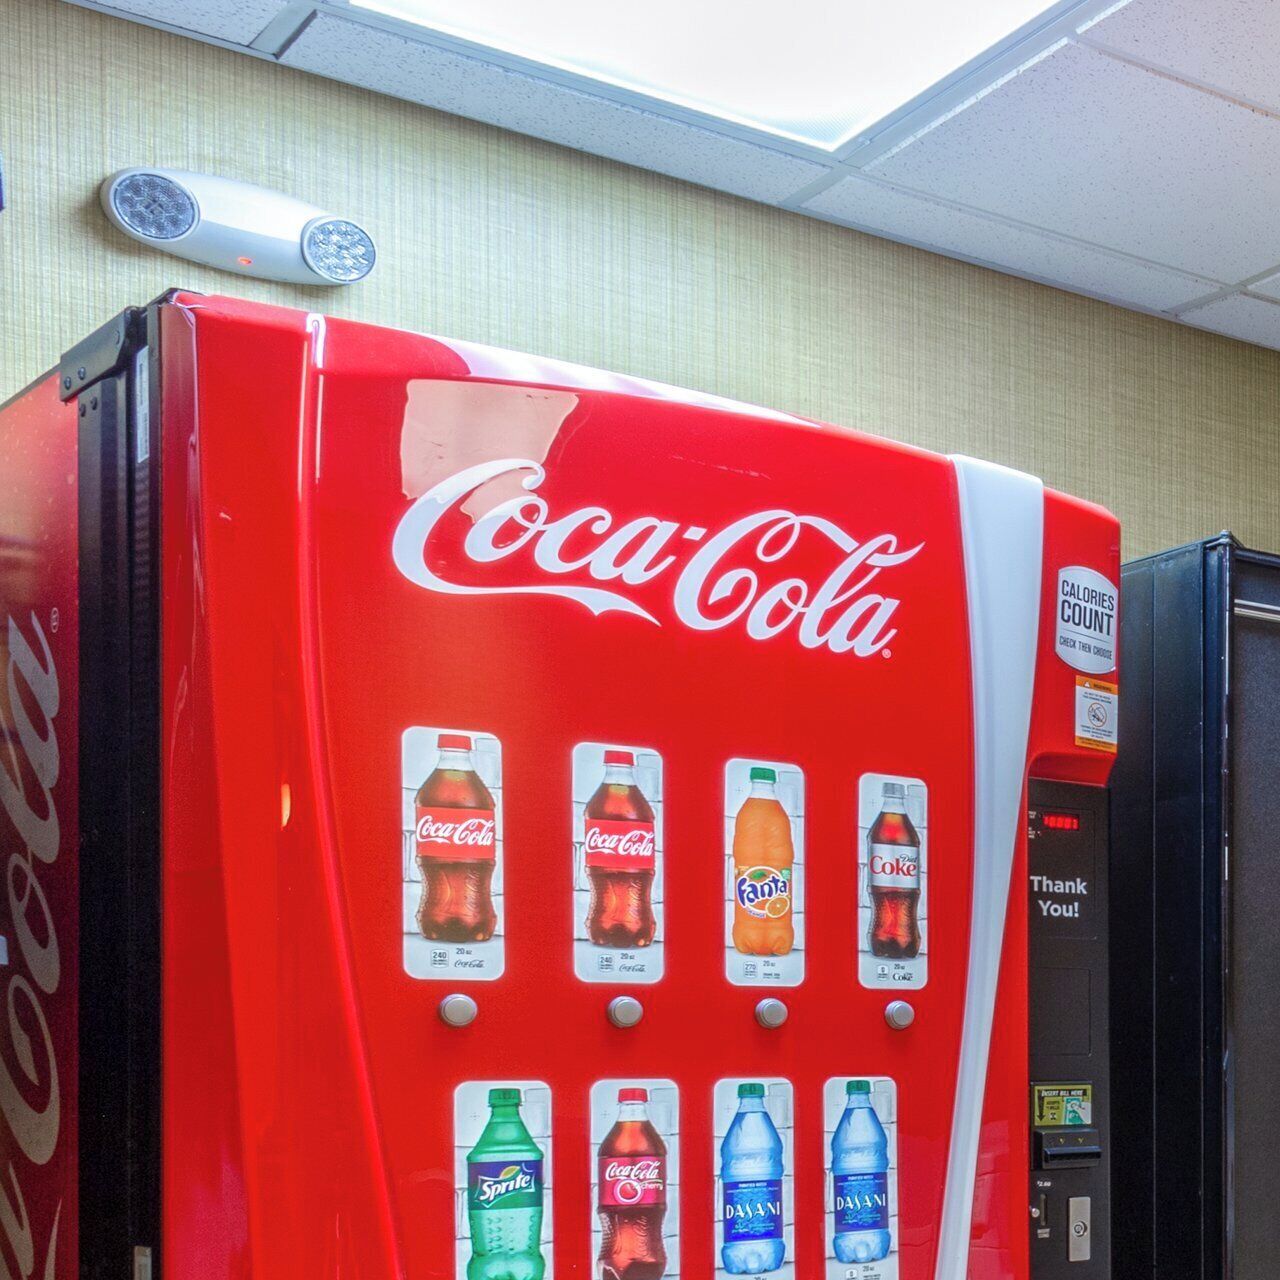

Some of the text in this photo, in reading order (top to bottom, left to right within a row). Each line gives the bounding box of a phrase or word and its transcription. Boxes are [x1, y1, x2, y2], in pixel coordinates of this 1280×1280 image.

[392, 458, 926, 658] Coca-Cola
[1061, 580, 1115, 612] CALORIES
[1060, 599, 1114, 636] COUNT
[1059, 635, 1112, 660] CHECK THEN CHOOSE
[416, 815, 494, 846] Coca-Cola
[584, 827, 654, 857] Coca-Cola
[870, 855, 917, 877] Coke
[900, 853, 918, 864] Diet
[737, 875, 788, 907] Fanta
[1030, 875, 1088, 895] Thank
[1038, 899, 1080, 918] You!
[432, 951, 447, 960] 240
[456, 947, 466, 955] 20
[600, 955, 613, 964] 240
[620, 952, 629, 960] 20
[605, 1160, 661, 1181] Coca-Cola
[479, 1173, 532, 1202] Sprite
[640, 1181, 664, 1192] cherry
[726, 1199, 781, 1219] DASANI
[836, 1191, 886, 1211] DASANI
